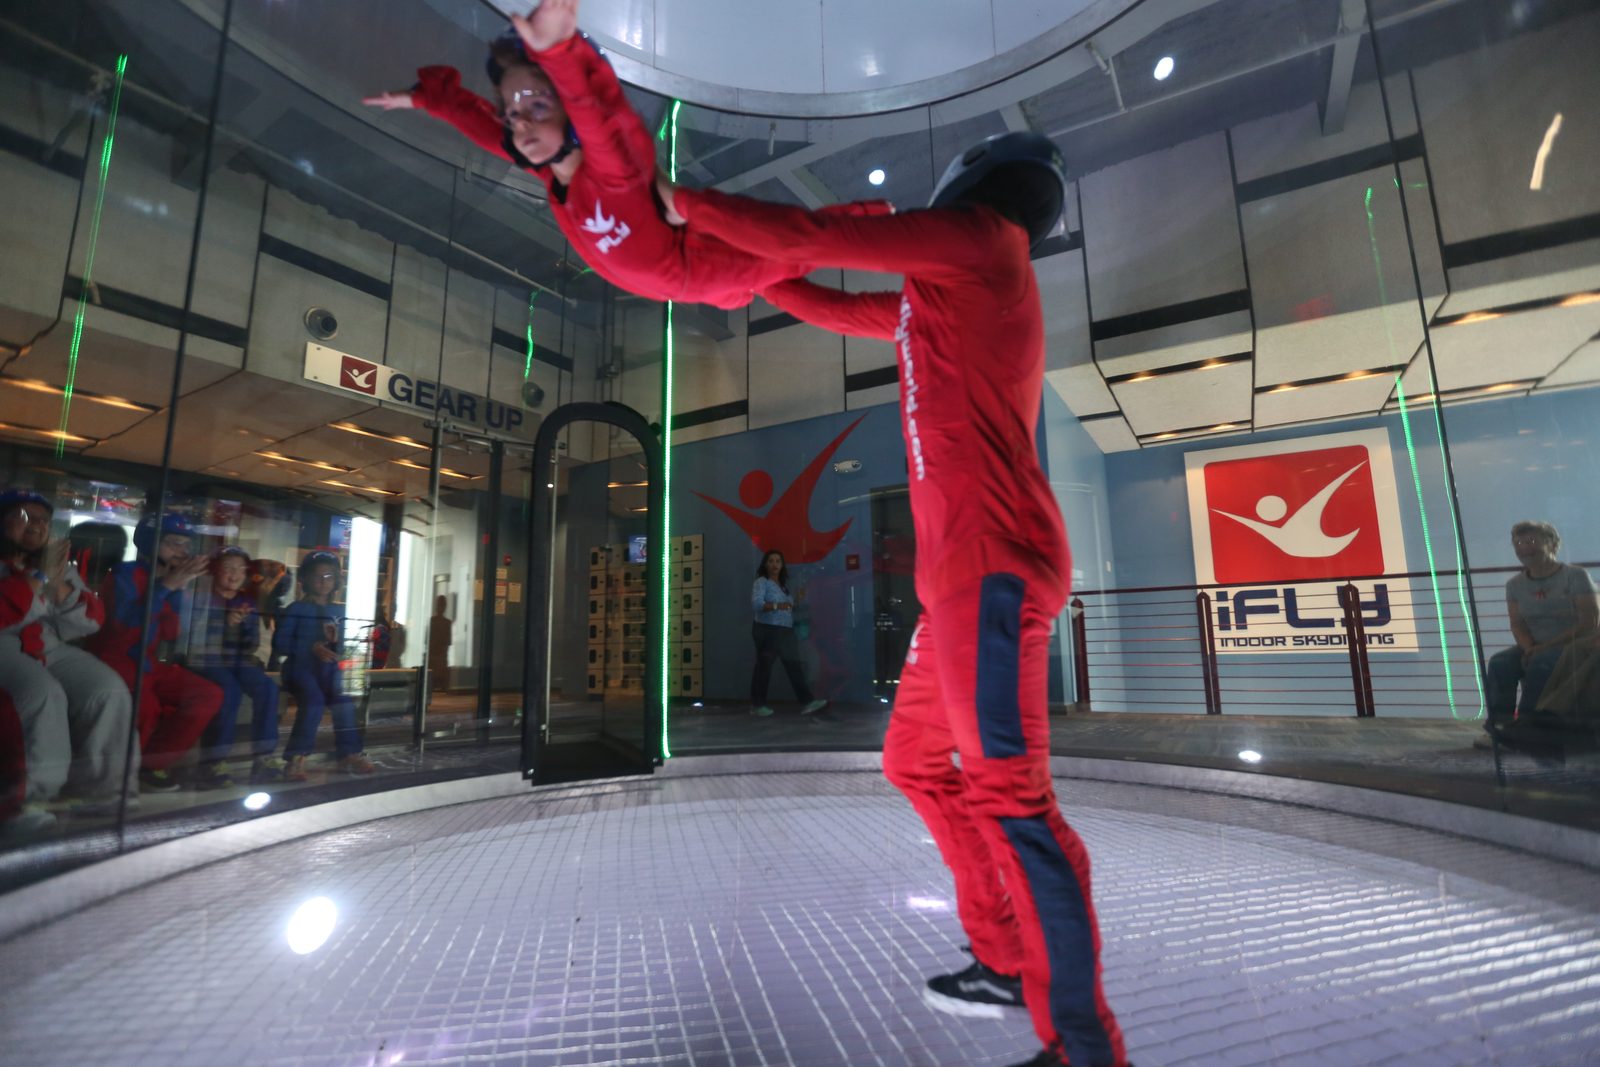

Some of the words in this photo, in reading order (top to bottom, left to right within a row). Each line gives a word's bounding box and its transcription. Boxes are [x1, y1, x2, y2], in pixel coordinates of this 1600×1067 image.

[387, 373, 476, 422] GEAR
[486, 401, 524, 431] UP
[1220, 636, 1287, 647] INDOOR
[1292, 633, 1395, 647] SKYDIING
